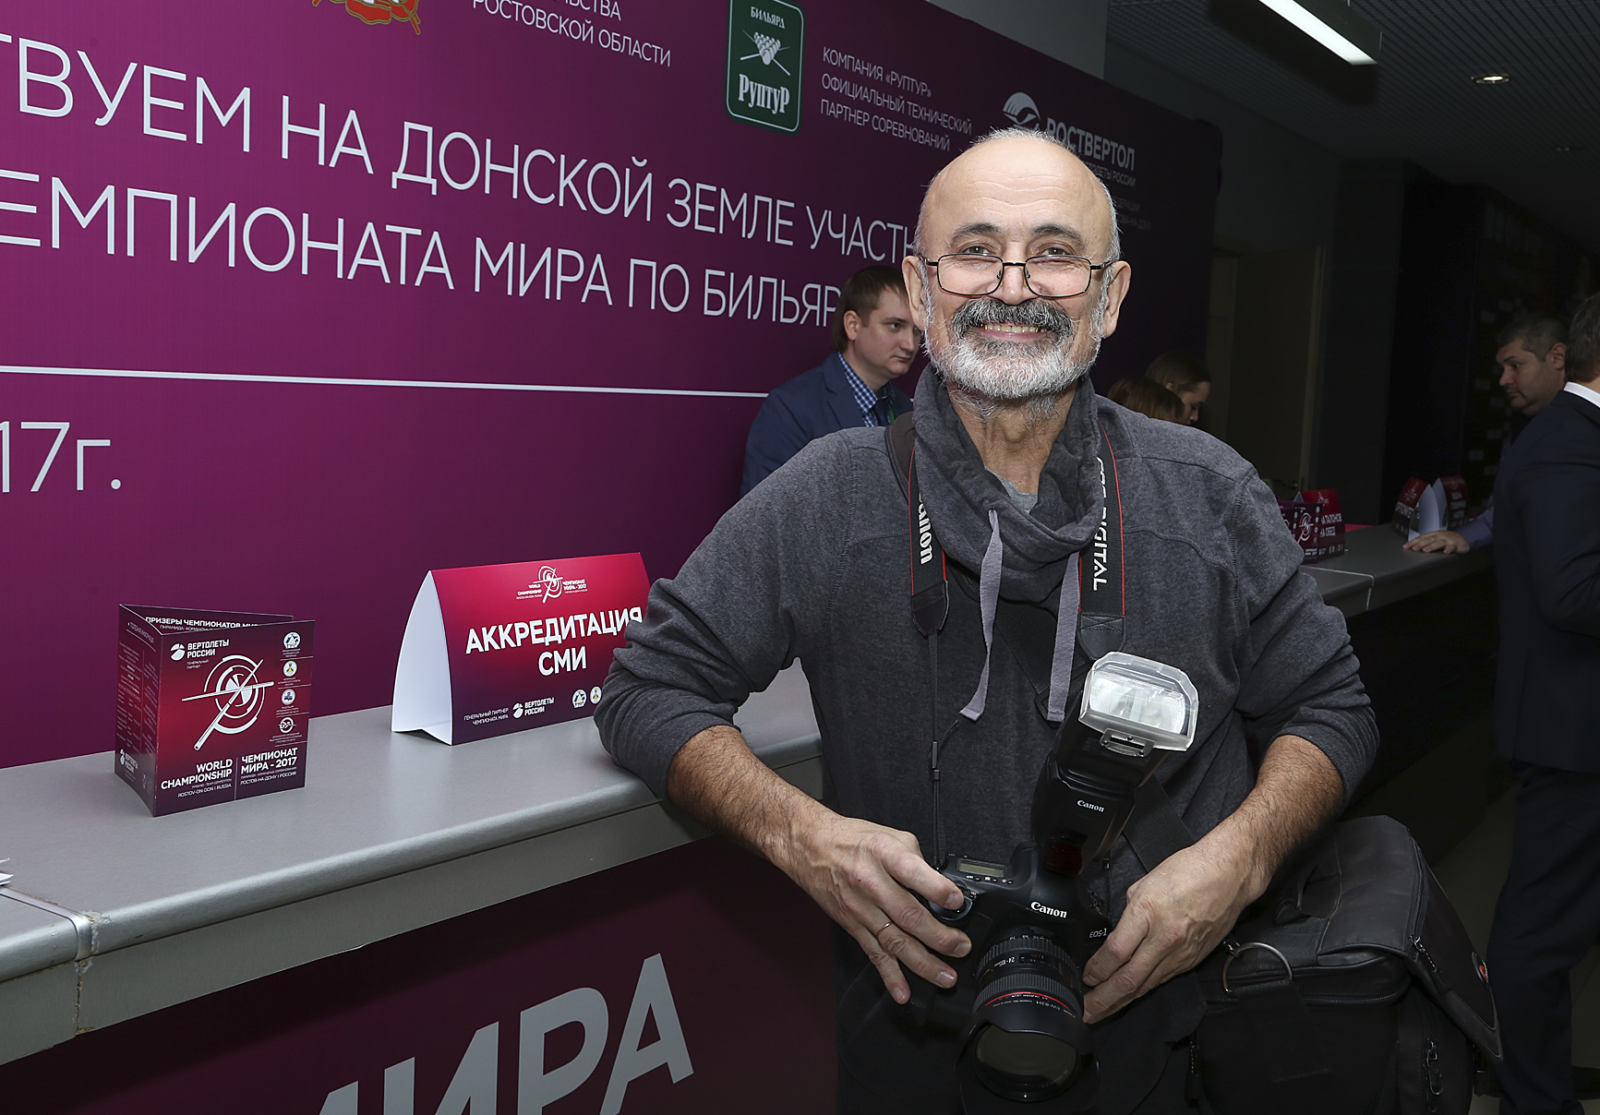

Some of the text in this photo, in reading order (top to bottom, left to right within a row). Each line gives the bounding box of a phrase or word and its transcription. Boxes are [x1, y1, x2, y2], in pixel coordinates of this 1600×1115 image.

[750, 6, 785, 29] БИЛЬЯРД
[598, 29, 671, 67] ОБЛАСТИ
[823, 46, 932, 98] КОМПАНИЯ «РУПТУР»
[821, 73, 973, 135] ОФИЦИАЛЬНЫЙ ТЕХНИЧЕСКИЙ
[820, 99, 951, 151] ПАРТНЕР СОРЕВНОВАНИЙ
[0, 32, 250, 152] ВУЕМ
[282, 95, 374, 175] НА
[391, 121, 652, 222] ДОНСКОЙ
[666, 178, 795, 246] ЗЕМЛЕ
[1046, 117, 1135, 171] РОСТВЕРТОЛ
[474, 237, 612, 305] МИРА
[628, 258, 690, 313] ПО
[918, 493, 933, 565] anon
[145, 616, 182, 626] ПРИЗЕРЫ
[465, 606, 642, 655] АККРЕДИТАЦИЯ
[186, 648, 216, 659] РОССИИ
[187, 639, 230, 651] ВЕРТОЛЕТЫ
[538, 646, 587, 676] СМИ
[524, 697, 555, 709] ВЕРТОЛЕТЫ
[524, 706, 545, 716] РОССИИ
[196, 759, 233, 774] WORLD
[240, 763, 269, 775] МИРА
[275, 757, 298, 769] 2017
[241, 747, 298, 765] ЧЕМПИОНАТ
[160, 768, 233, 790] CHAMPIONSHIP
[1076, 799, 1105, 813] Canon
[1030, 901, 1068, 919] Canon
